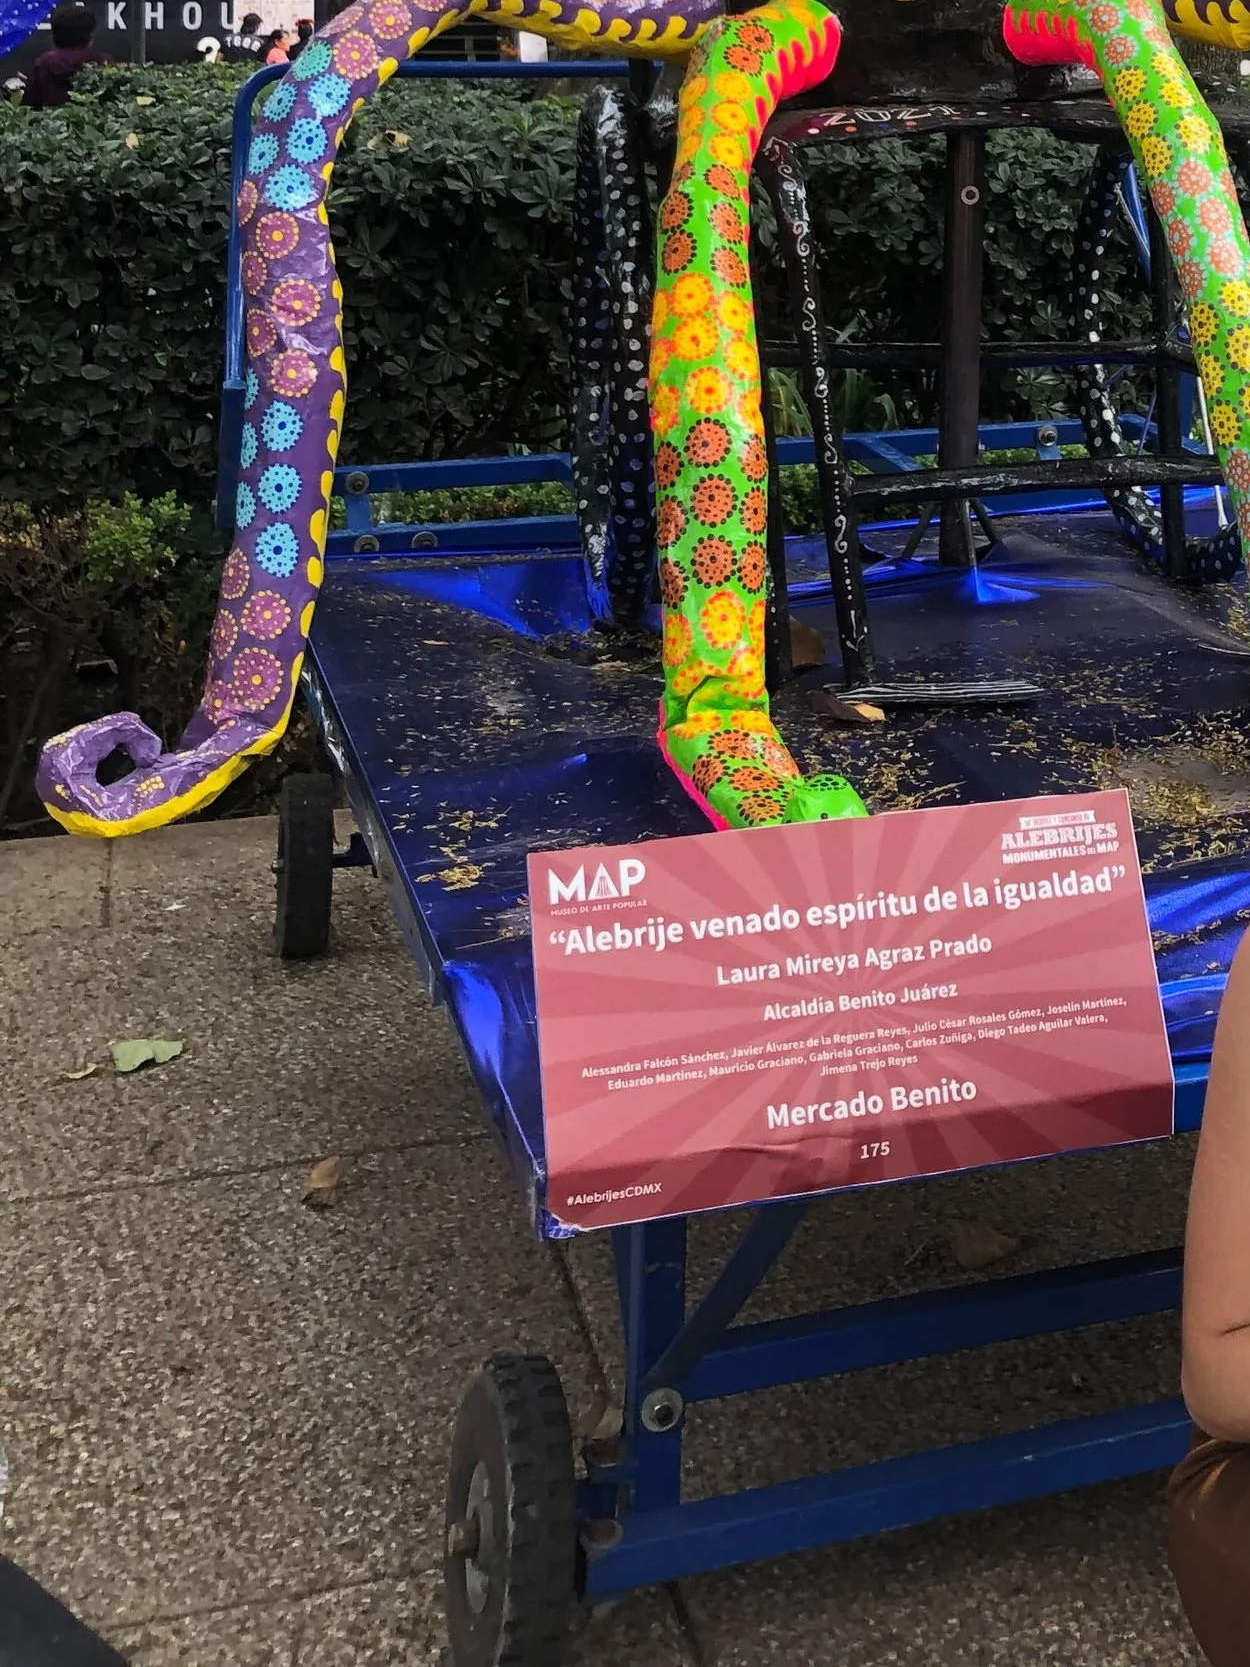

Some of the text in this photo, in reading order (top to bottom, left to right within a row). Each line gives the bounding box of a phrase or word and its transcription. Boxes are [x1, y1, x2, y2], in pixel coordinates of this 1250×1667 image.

[1001, 822, 1118, 850] ALEBRIJES
[1002, 844, 1087, 865] MONUMENTALES
[1096, 840, 1120, 854] MAP
[547, 858, 646, 905] MAP
[549, 864, 1126, 956] “Alebrije venado espíritu de la igualdad”
[717, 934, 992, 986] Laura Mireya Agraz Prado
[764, 983, 958, 1021] Alcaldía Benito Juárez
[581, 1061, 641, 1078] Alessandra
[644, 1055, 678, 1070] Falcón
[681, 1050, 728, 1068] Sánchez,
[730, 1044, 763, 1059] Javier
[766, 1039, 804, 1054] Álvarez
[806, 1037, 819, 1048] de
[821, 1035, 831, 1047] la
[833, 1030, 875, 1048] Reguera
[877, 1026, 910, 1041] Reyes,
[912, 1021, 937, 1034] Julio
[940, 1017, 967, 1029] César
[969, 1013, 1006, 1026] Rosales
[1008, 1007, 1045, 1022] Gómez,
[1046, 1001, 1081, 1016] Joselín
[608, 1077, 653, 1091] Eduardo
[709, 1062, 754, 1077] Mauricio
[757, 1055, 807, 1070] Graciano,
[809, 1047, 852, 1063] Gabriela
[855, 1041, 904, 1055] Graciano,
[906, 1036, 937, 1049] Carlos
[978, 1026, 1005, 1041] Diego
[1008, 1023, 1036, 1035] Tadeo
[1039, 1018, 1073, 1032] Aguilar
[1074, 1014, 1109, 1027] Valera,
[819, 1054, 918, 1077] Jimena Trejo Reyes
[767, 1078, 977, 1130] Mercado Benito
[860, 1141, 890, 1160] 175
[566, 1182, 662, 1207] #AlebrijesCDMX
